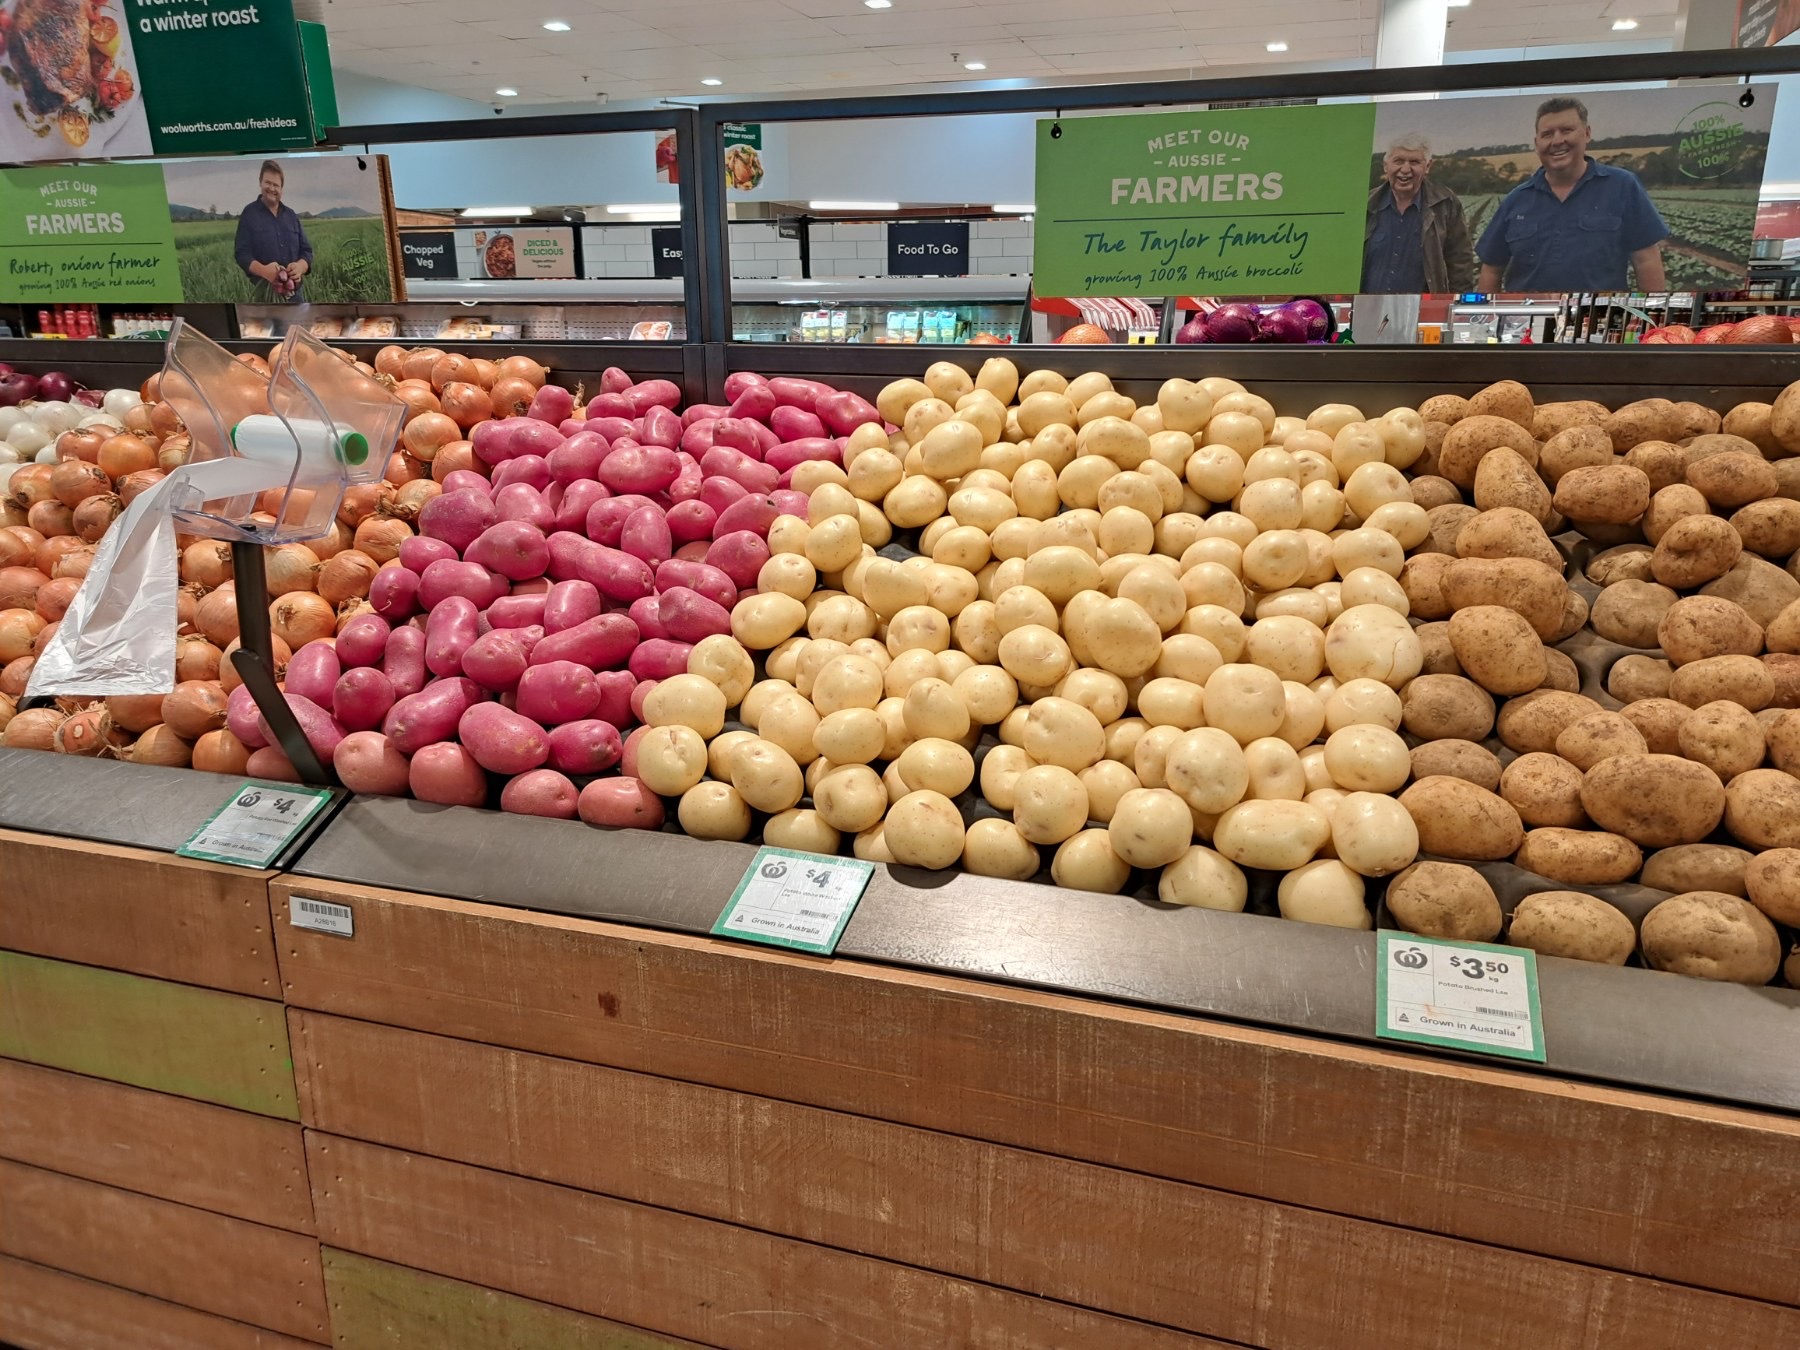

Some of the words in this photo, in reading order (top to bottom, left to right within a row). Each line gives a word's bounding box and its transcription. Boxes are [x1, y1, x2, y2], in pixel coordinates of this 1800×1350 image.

[140, 18, 152, 33] a
[154, 10, 208, 32] winter
[212, 5, 259, 26] roast
[160, 117, 297, 134] woolworths.com.au/freshideas
[1693, 114, 1726, 130] 100%
[1147, 130, 1202, 154] MEET
[1208, 130, 1250, 151] OUR
[1679, 122, 1744, 153] AUSSIE
[1168, 153, 1226, 168] AUSSIE
[40, 180, 69, 197] MEET
[74, 180, 98, 196] OUR
[1111, 172, 1284, 205] FARMERS
[55, 198, 87, 208] AUSSIE
[26, 212, 125, 235] FARMERS
[404, 244, 444, 256] Chopped
[898, 244, 924, 255] Food
[927, 244, 940, 254] To
[942, 244, 959, 254] Go
[1084, 232, 1126, 255] The
[1140, 229, 1210, 265] Taylor
[1218, 222, 1310, 260] family
[10, 258, 53, 276] Robert,
[62, 255, 104, 271] onion
[108, 252, 160, 276] farmer
[342, 253, 375, 272] AUSSIE
[416, 257, 434, 269] Veg
[109, 275, 122, 287] red
[1084, 268, 1142, 290] growing
[1149, 265, 1188, 282] 100%
[1196, 264, 1239, 280] Aussie
[1246, 262, 1304, 278] broccoli
[274, 798, 296, 814] $4
[806, 868, 832, 888] $4
[751, 917, 777, 927] Grown
[778, 920, 784, 928] in
[786, 923, 820, 935] Australia
[1420, 1016, 1454, 1028] Grown
[1457, 1021, 1466, 1030] in
[1470, 1024, 1516, 1037] Australia
